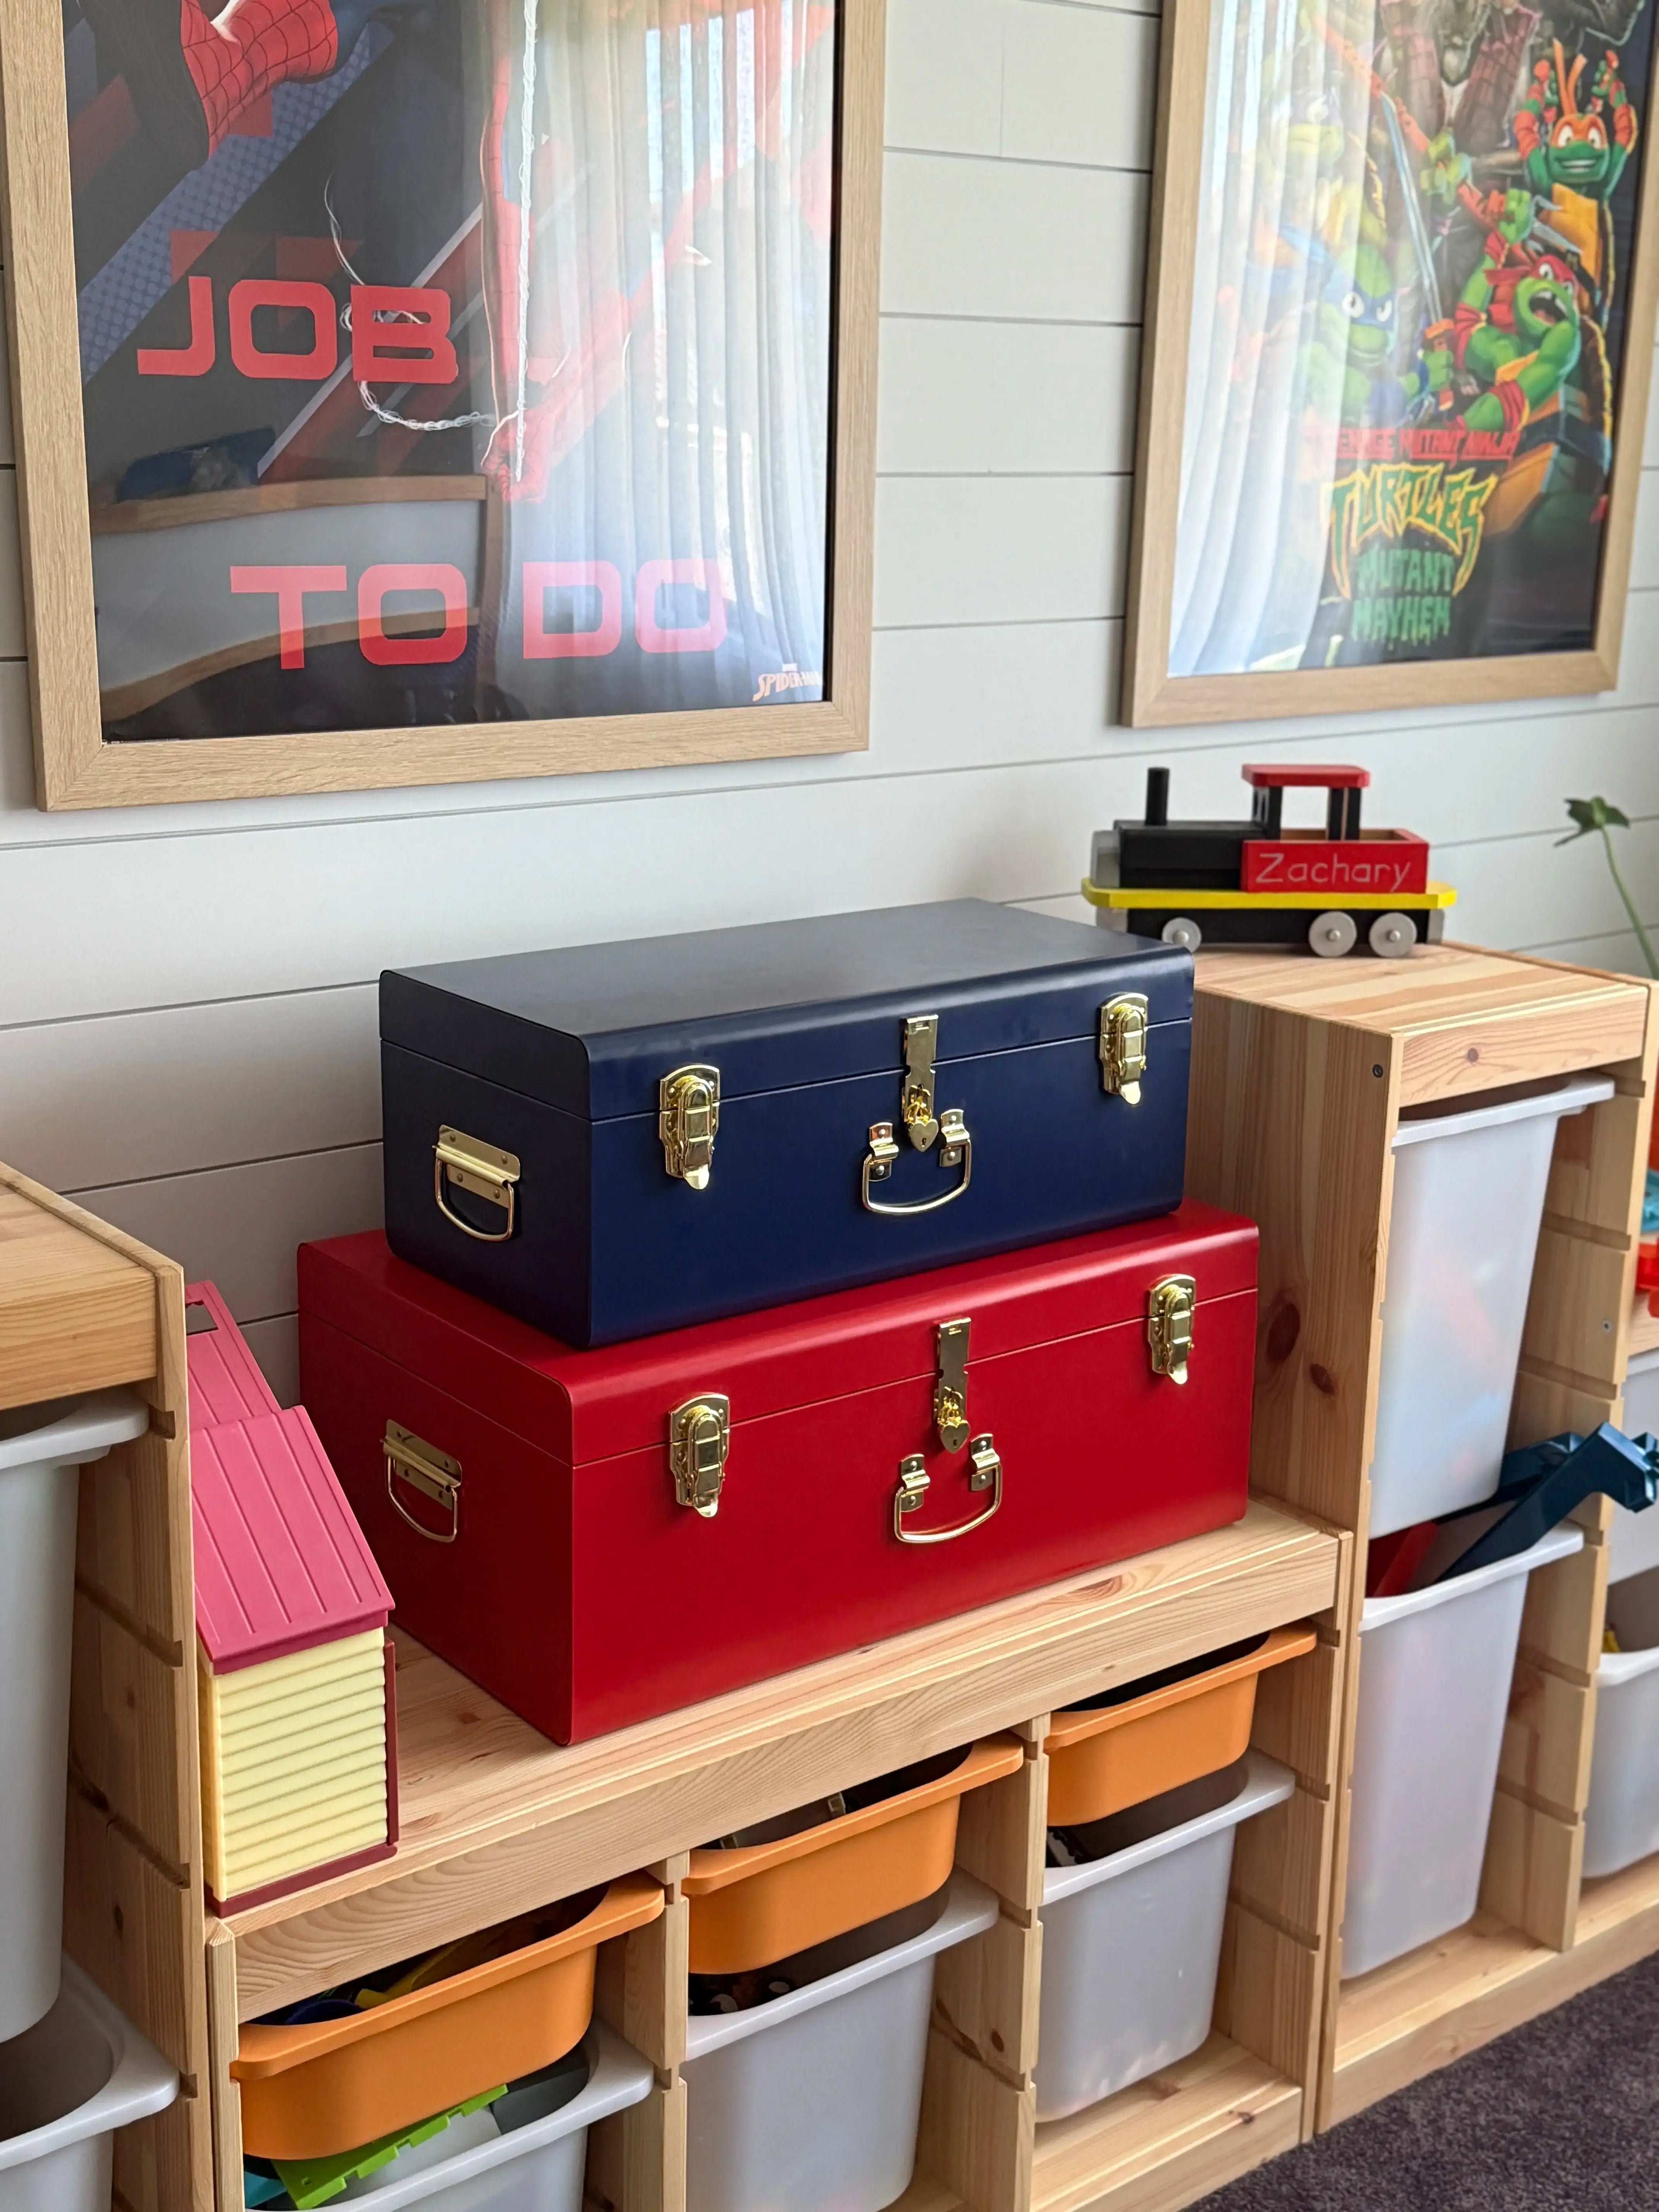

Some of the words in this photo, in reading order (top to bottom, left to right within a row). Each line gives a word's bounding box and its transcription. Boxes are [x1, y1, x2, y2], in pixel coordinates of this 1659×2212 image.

[137, 276, 457, 384] JOB
[1305, 428, 1395, 461] ENAGE
[1320, 462, 1499, 600] TURTLES
[1356, 544, 1455, 592] MUTANT
[230, 563, 467, 669] TO
[523, 558, 728, 659] DO
[1351, 596, 1451, 646] MAYHEM
[752, 671, 822, 702] SPIDER-M
[1255, 853, 1411, 893] Zachary
